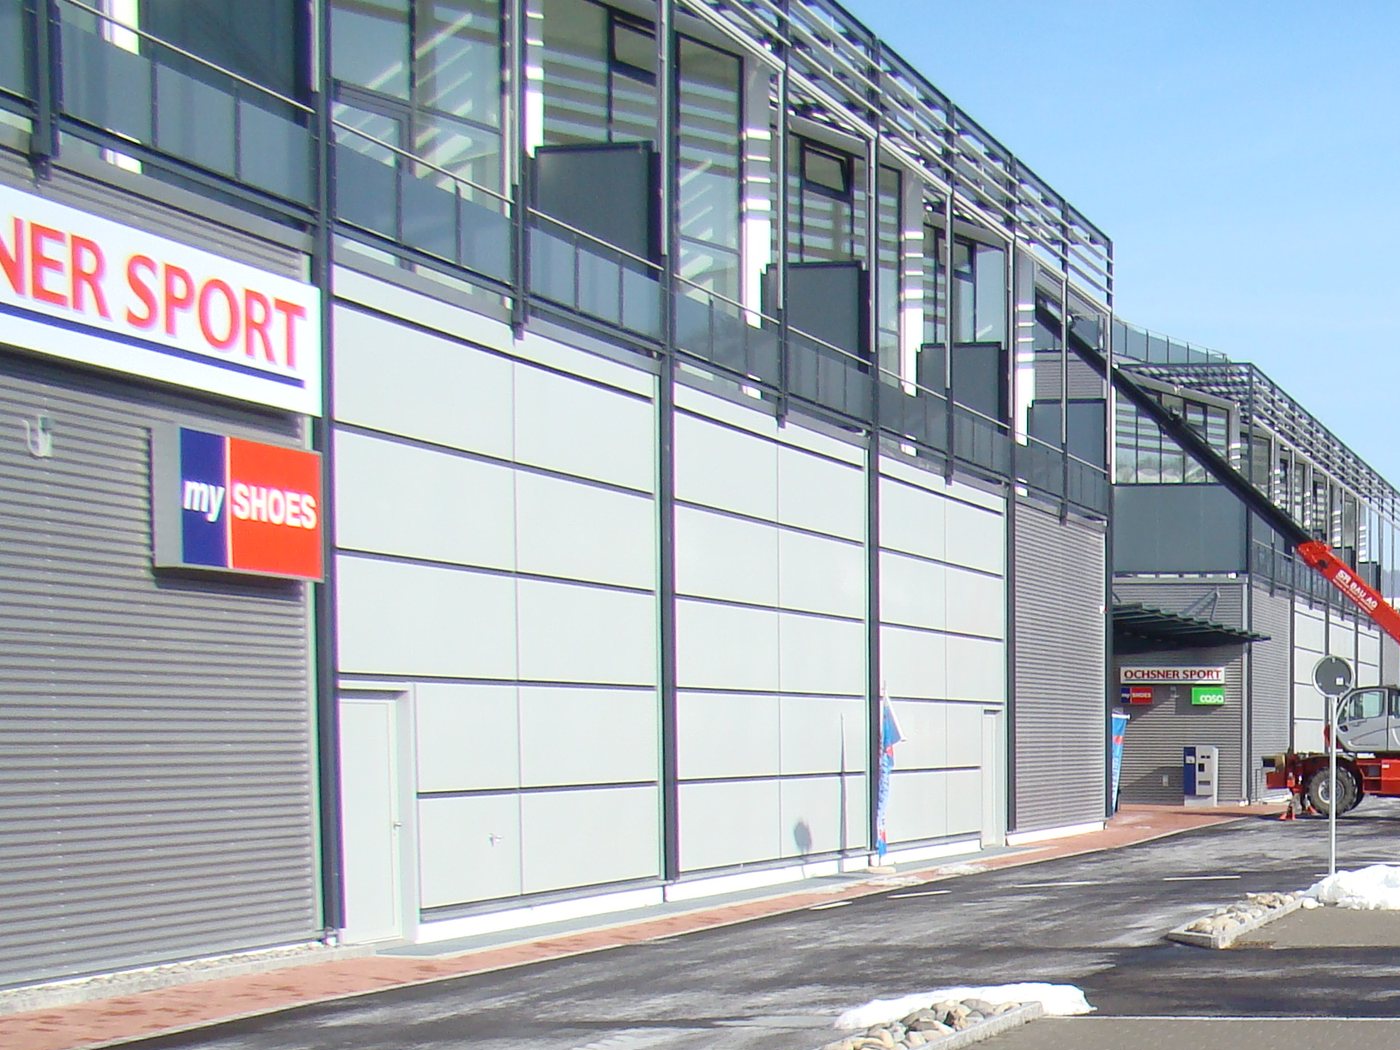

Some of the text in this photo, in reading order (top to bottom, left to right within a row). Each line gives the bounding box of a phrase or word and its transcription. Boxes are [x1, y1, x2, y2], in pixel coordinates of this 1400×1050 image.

[126, 253, 308, 370] SPORT
[183, 480, 317, 529] my SHOES
[1124, 669, 1222, 679] OCHSNER SPORT
[1199, 694, 1224, 703] casa
